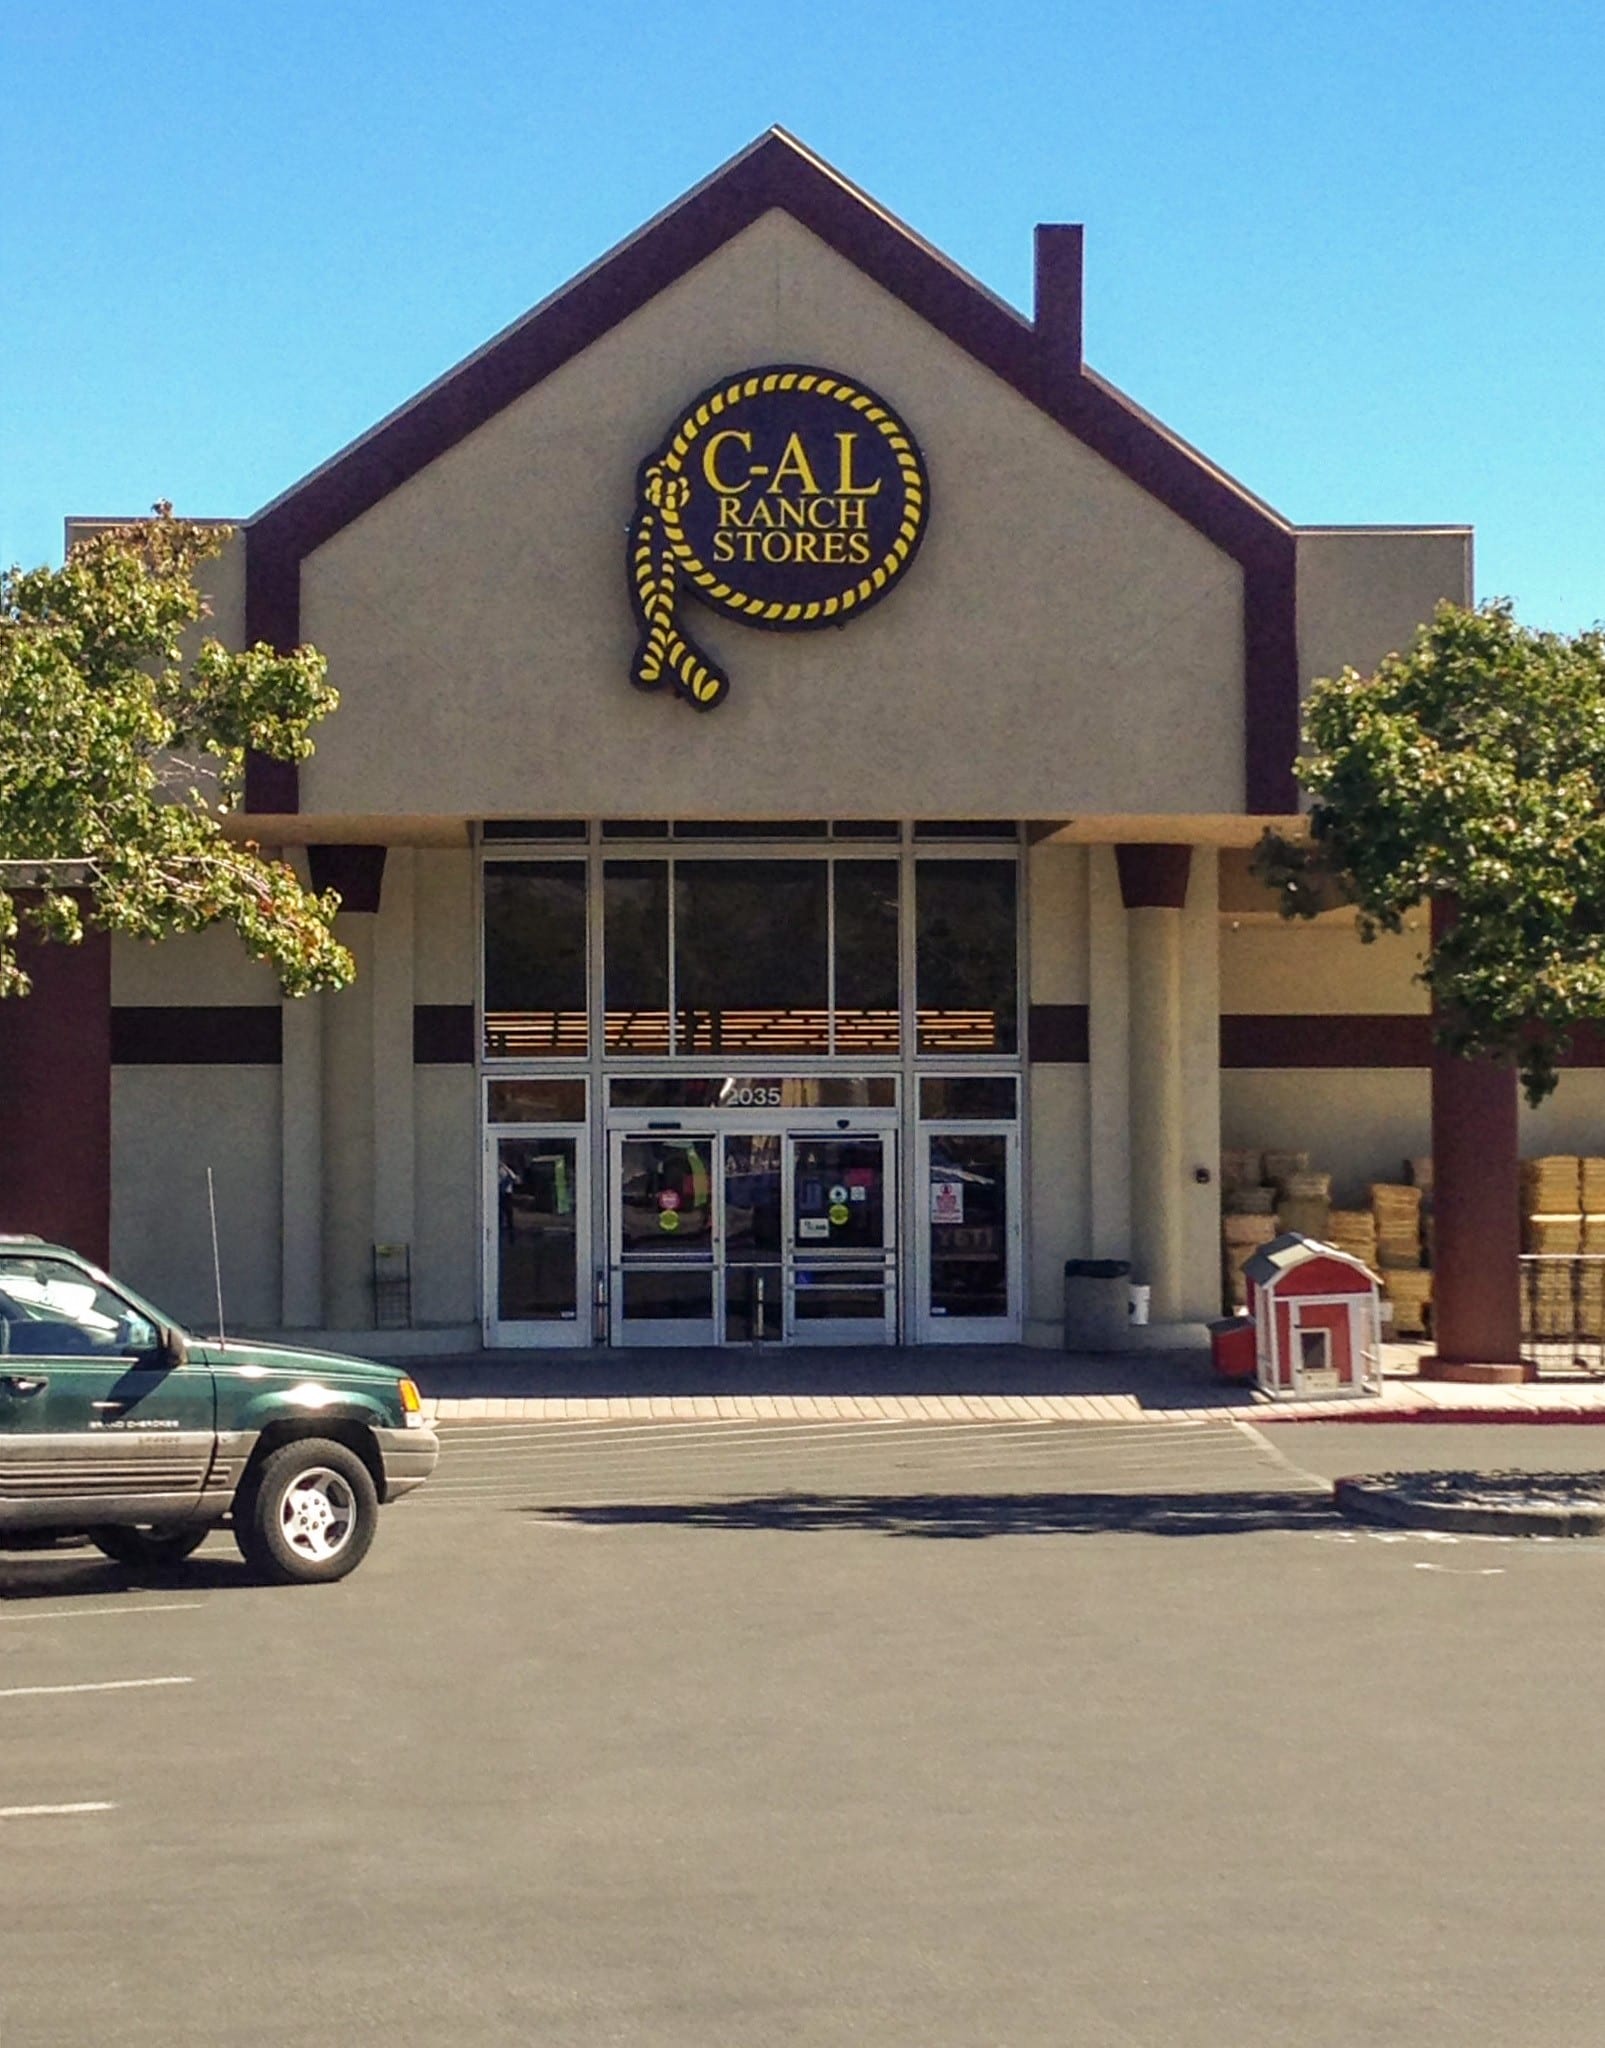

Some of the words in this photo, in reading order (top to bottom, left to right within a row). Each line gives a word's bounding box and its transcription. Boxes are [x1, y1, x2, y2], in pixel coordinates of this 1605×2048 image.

[702, 429, 882, 495] C-AL
[717, 496, 869, 530] RANCH
[713, 531, 871, 564] STORES
[726, 1087, 781, 1105] 2035
